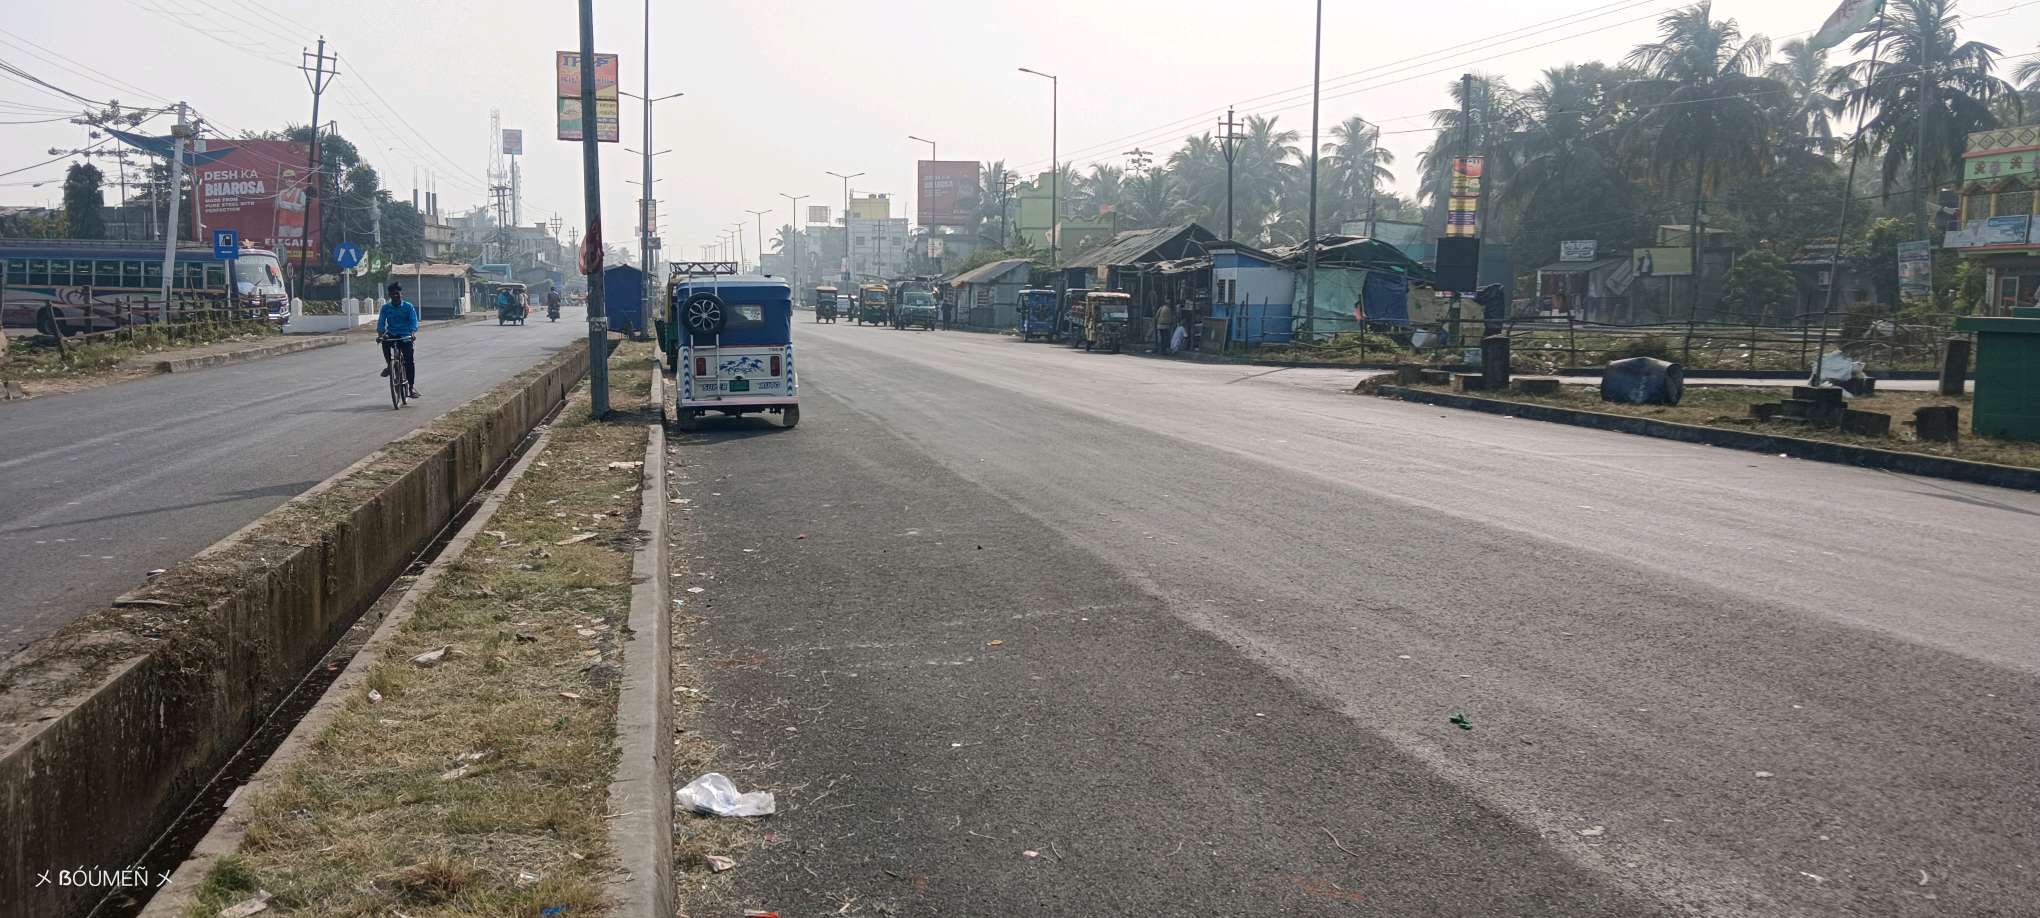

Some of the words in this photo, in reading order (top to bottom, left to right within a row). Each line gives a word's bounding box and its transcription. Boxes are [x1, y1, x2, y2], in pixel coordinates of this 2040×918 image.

[204, 171, 238, 180] DESH
[241, 169, 258, 179] KA
[205, 181, 265, 195] BHAROSA
